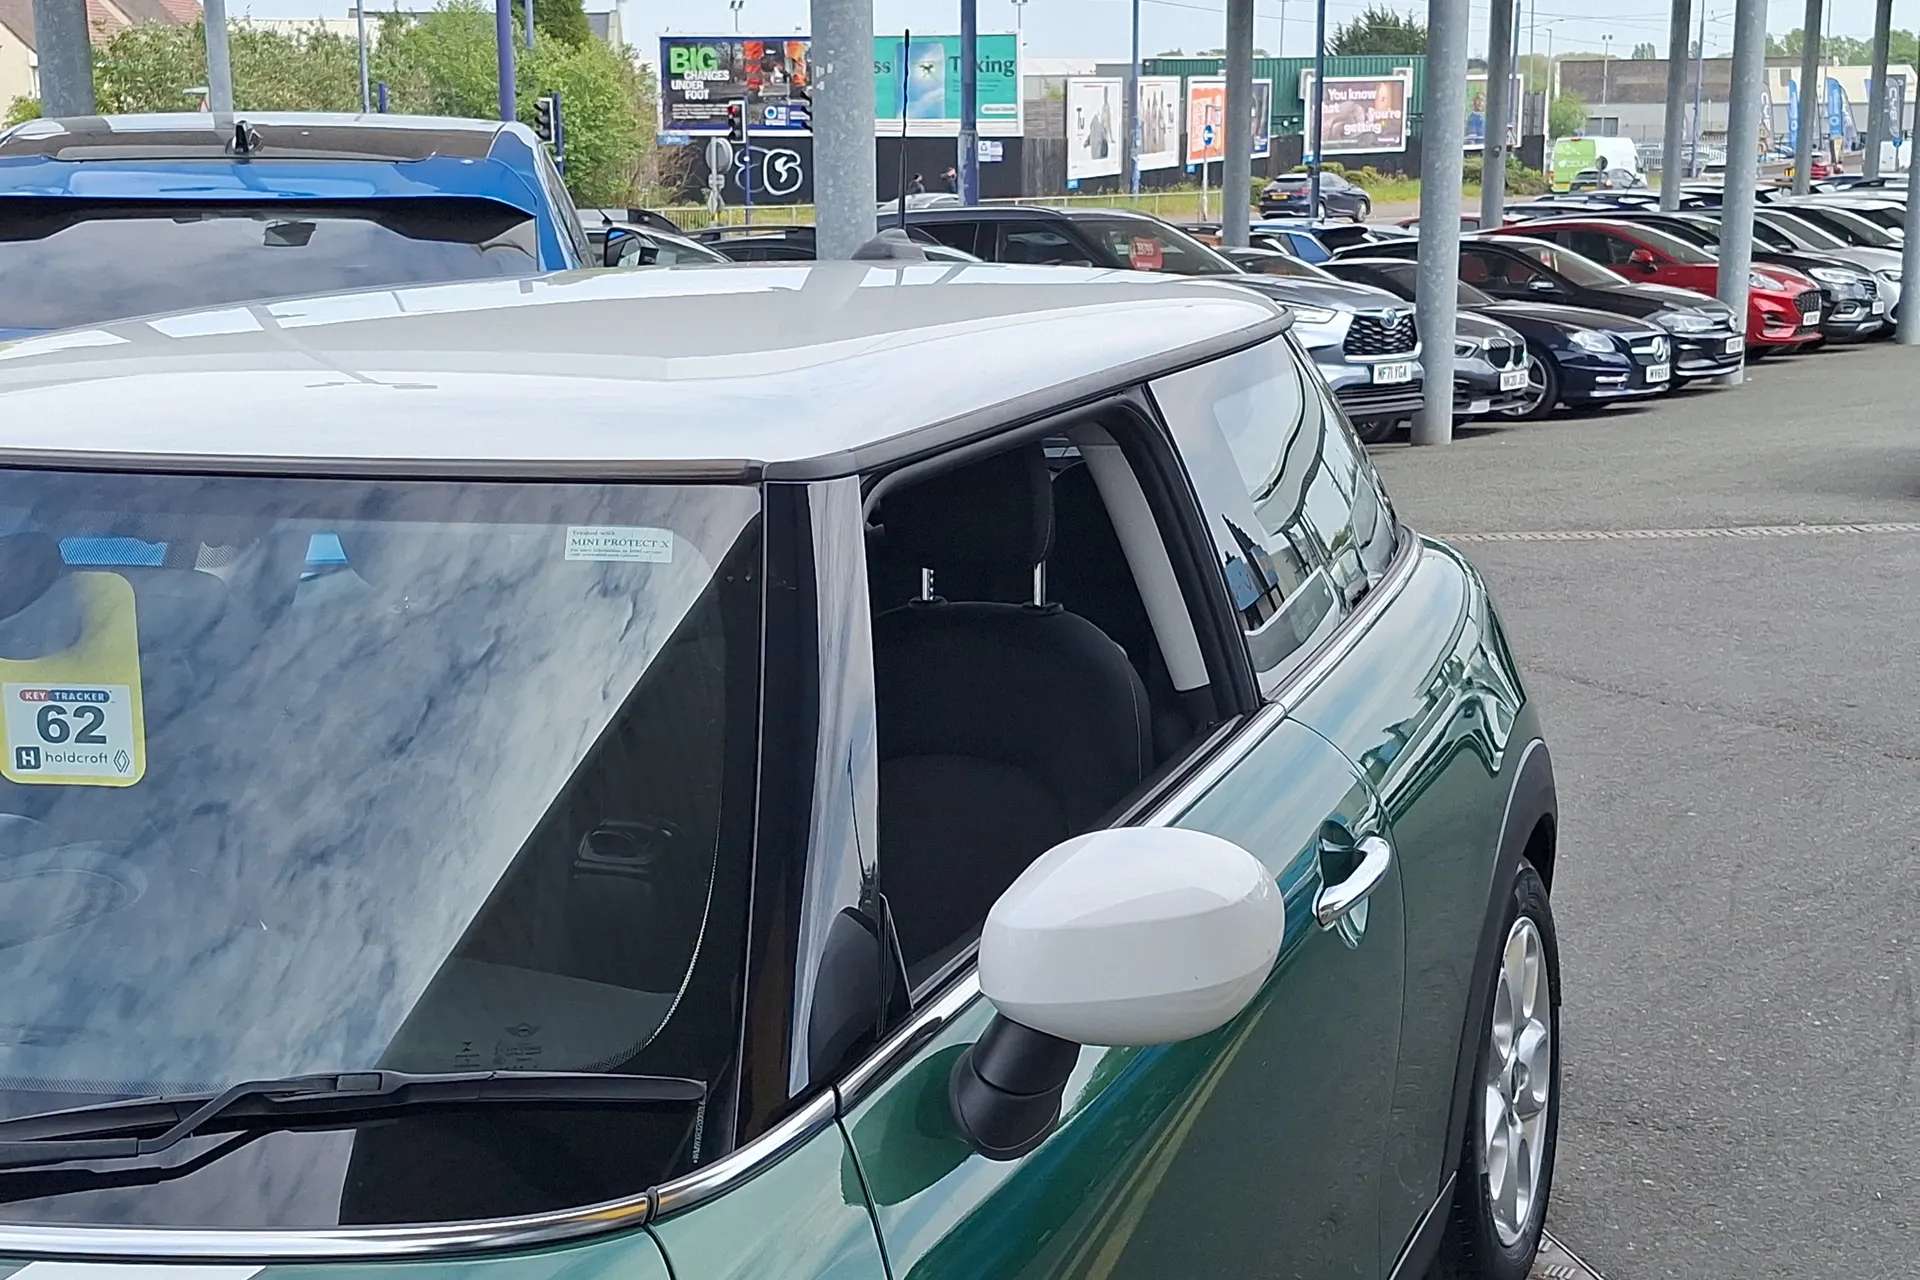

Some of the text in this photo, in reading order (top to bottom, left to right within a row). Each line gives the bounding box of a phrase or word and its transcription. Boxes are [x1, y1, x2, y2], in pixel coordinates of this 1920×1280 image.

[670, 46, 719, 74] BIG
[684, 70, 730, 81] CHANGES
[671, 80, 704, 90] UNDER
[684, 89, 710, 100] FOOT
[1328, 88, 1376, 101] You know
[1343, 121, 1382, 135] getting
[571, 538, 669, 548] MINI PROTECT X
[24, 691, 105, 702] KEY TRACKER
[36, 704, 107, 744] 62
[45, 751, 108, 764] holdcroft
